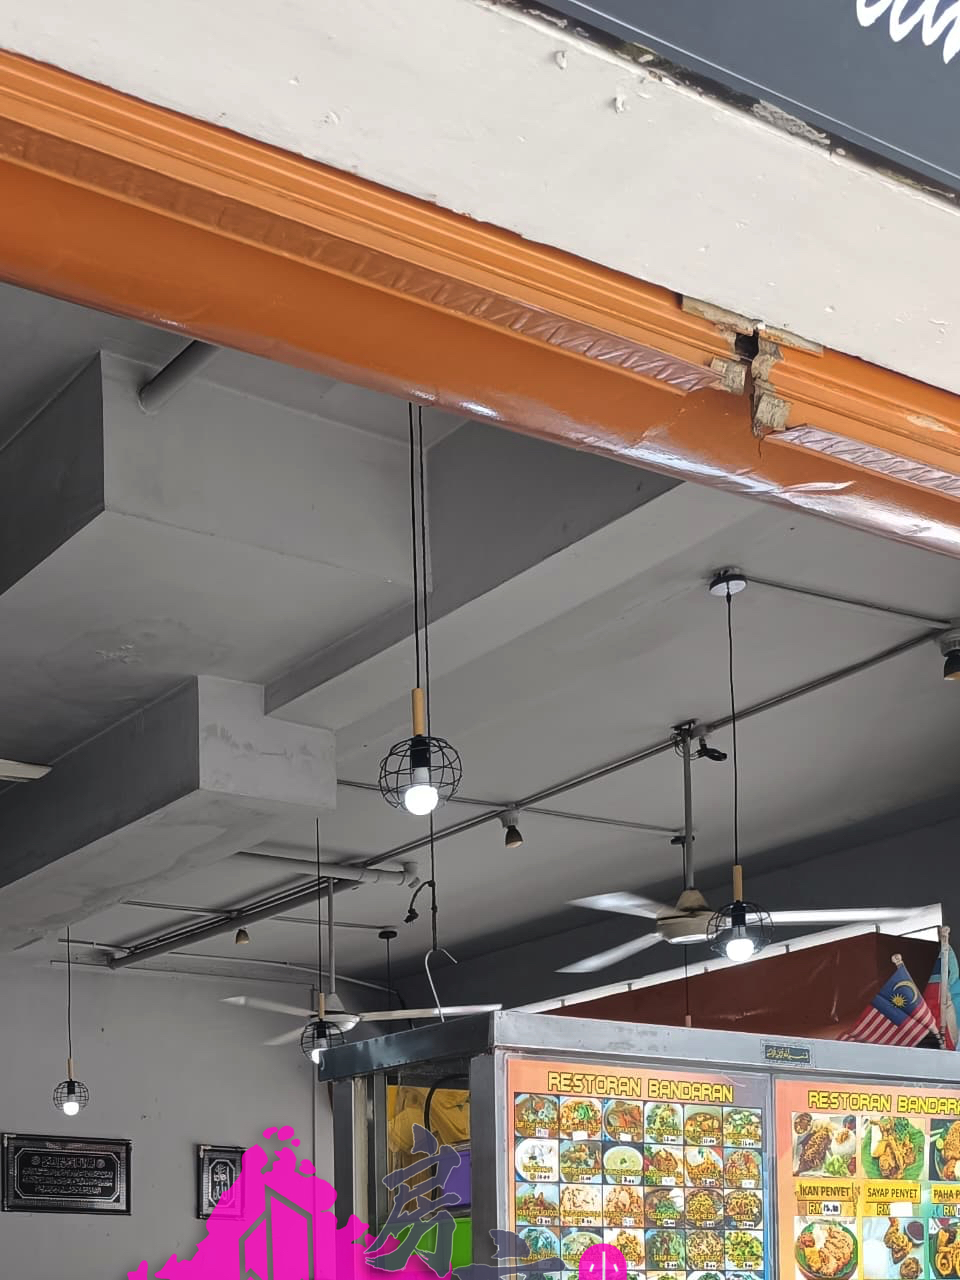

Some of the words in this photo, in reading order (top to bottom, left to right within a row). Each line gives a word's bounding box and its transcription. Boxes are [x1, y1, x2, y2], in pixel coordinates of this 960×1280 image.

[548, 1071, 641, 1098] RESTORAN
[648, 1079, 734, 1104] BANDARAN
[808, 1090, 892, 1112] RESTORAN
[820, 1186, 851, 1197] PENYET
[867, 1187, 890, 1198] SAYAP
[891, 1188, 919, 1199] PENYET
[933, 1189, 954, 1200] PAHA
